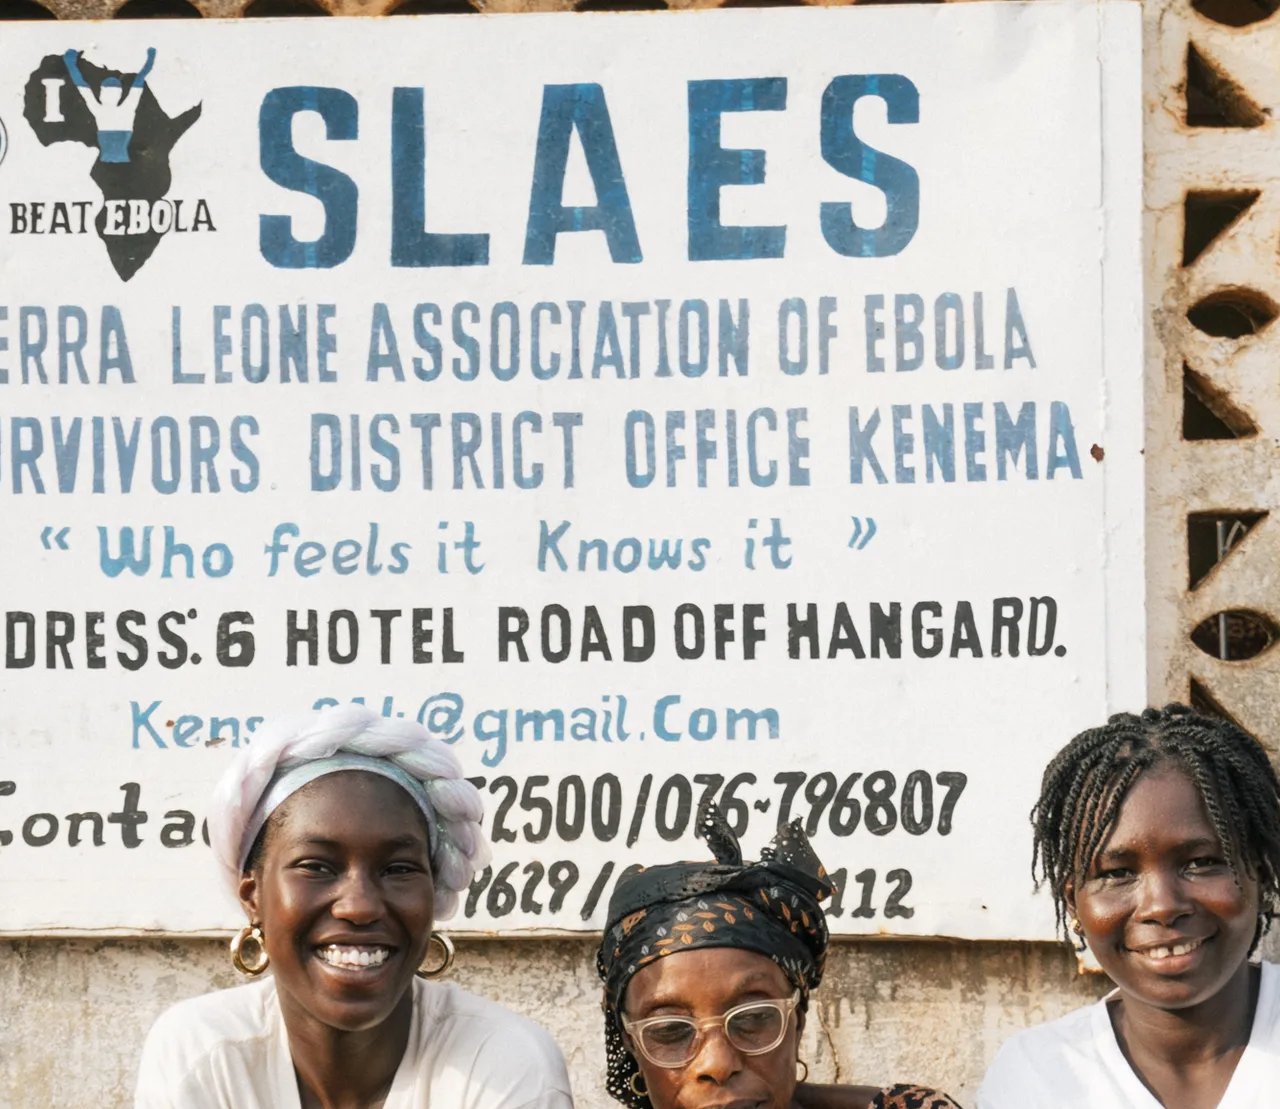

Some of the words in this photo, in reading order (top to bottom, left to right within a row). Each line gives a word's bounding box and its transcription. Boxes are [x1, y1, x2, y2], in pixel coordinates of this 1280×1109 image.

[41, 78, 66, 123] I
[258, 74, 920, 269] SLAES
[9, 202, 93, 234] BEAT
[103, 199, 217, 235] EBOLA
[172, 304, 337, 384] LEONE
[367, 299, 749, 382] ASSOCIATION
[779, 297, 836, 375] OF
[865, 288, 1036, 372] EBOLA
[310, 411, 582, 492] DISTRICT
[625, 408, 809, 488] OFFICE
[850, 401, 1082, 484] KENEMA
[98, 526, 233, 578] Who
[265, 523, 411, 577] feels
[438, 522, 484, 574] it
[538, 520, 710, 573] Knows
[746, 519, 791, 569] it
[216, 611, 255, 667] 6
[286, 607, 464, 666] HOTEL
[498, 604, 655, 663] ROAD
[674, 603, 766, 660] OFF
[787, 596, 1067, 659] HANGARD.
